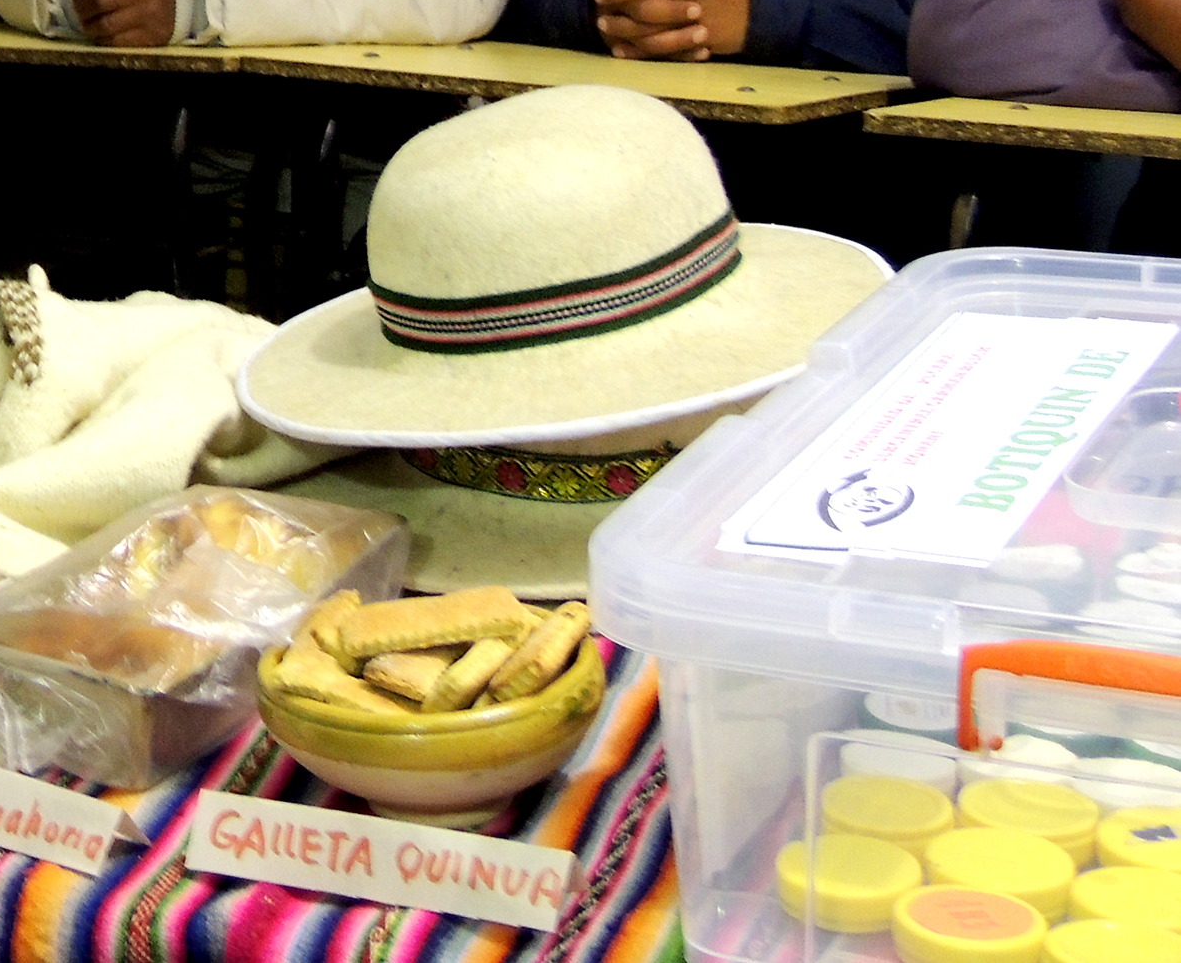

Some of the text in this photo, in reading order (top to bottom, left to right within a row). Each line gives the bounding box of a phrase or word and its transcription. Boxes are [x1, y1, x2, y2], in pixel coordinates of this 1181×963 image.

[955, 349, 1129, 512] BOTIQUIN DE
[396, 841, 563, 910] QUINUA
